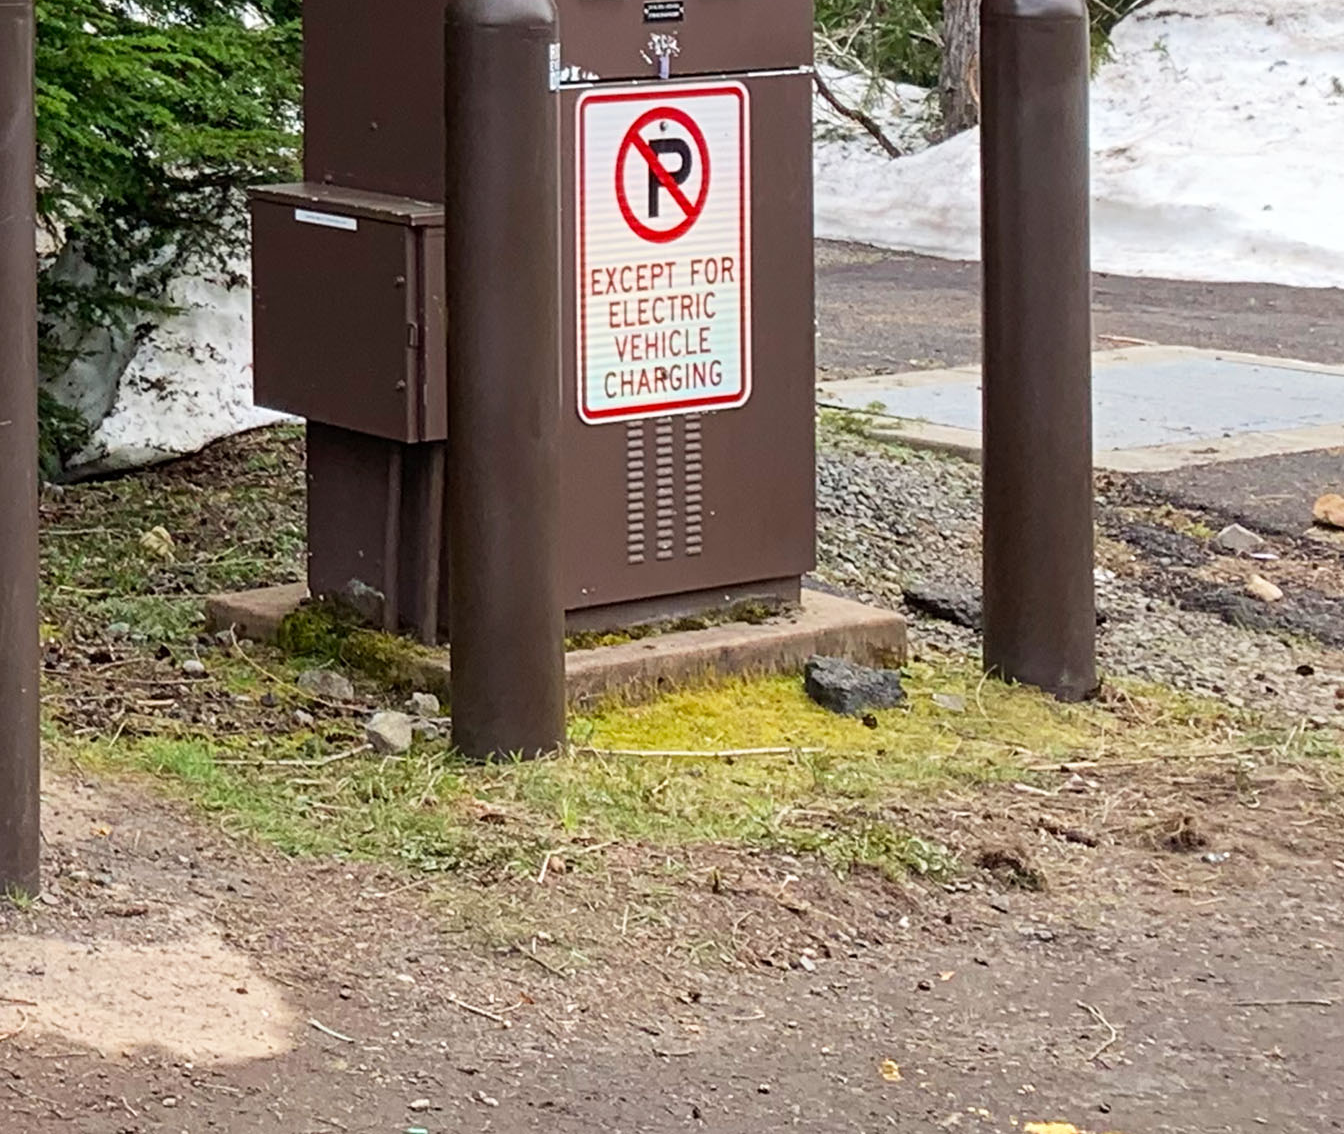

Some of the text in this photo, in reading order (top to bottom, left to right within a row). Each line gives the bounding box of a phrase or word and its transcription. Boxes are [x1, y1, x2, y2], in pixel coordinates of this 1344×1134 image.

[590, 256, 735, 297] EXCEPT FOR
[608, 291, 717, 329] ELECTRIC
[614, 326, 712, 363] VEHICLE
[603, 359, 723, 400] CHARGING
